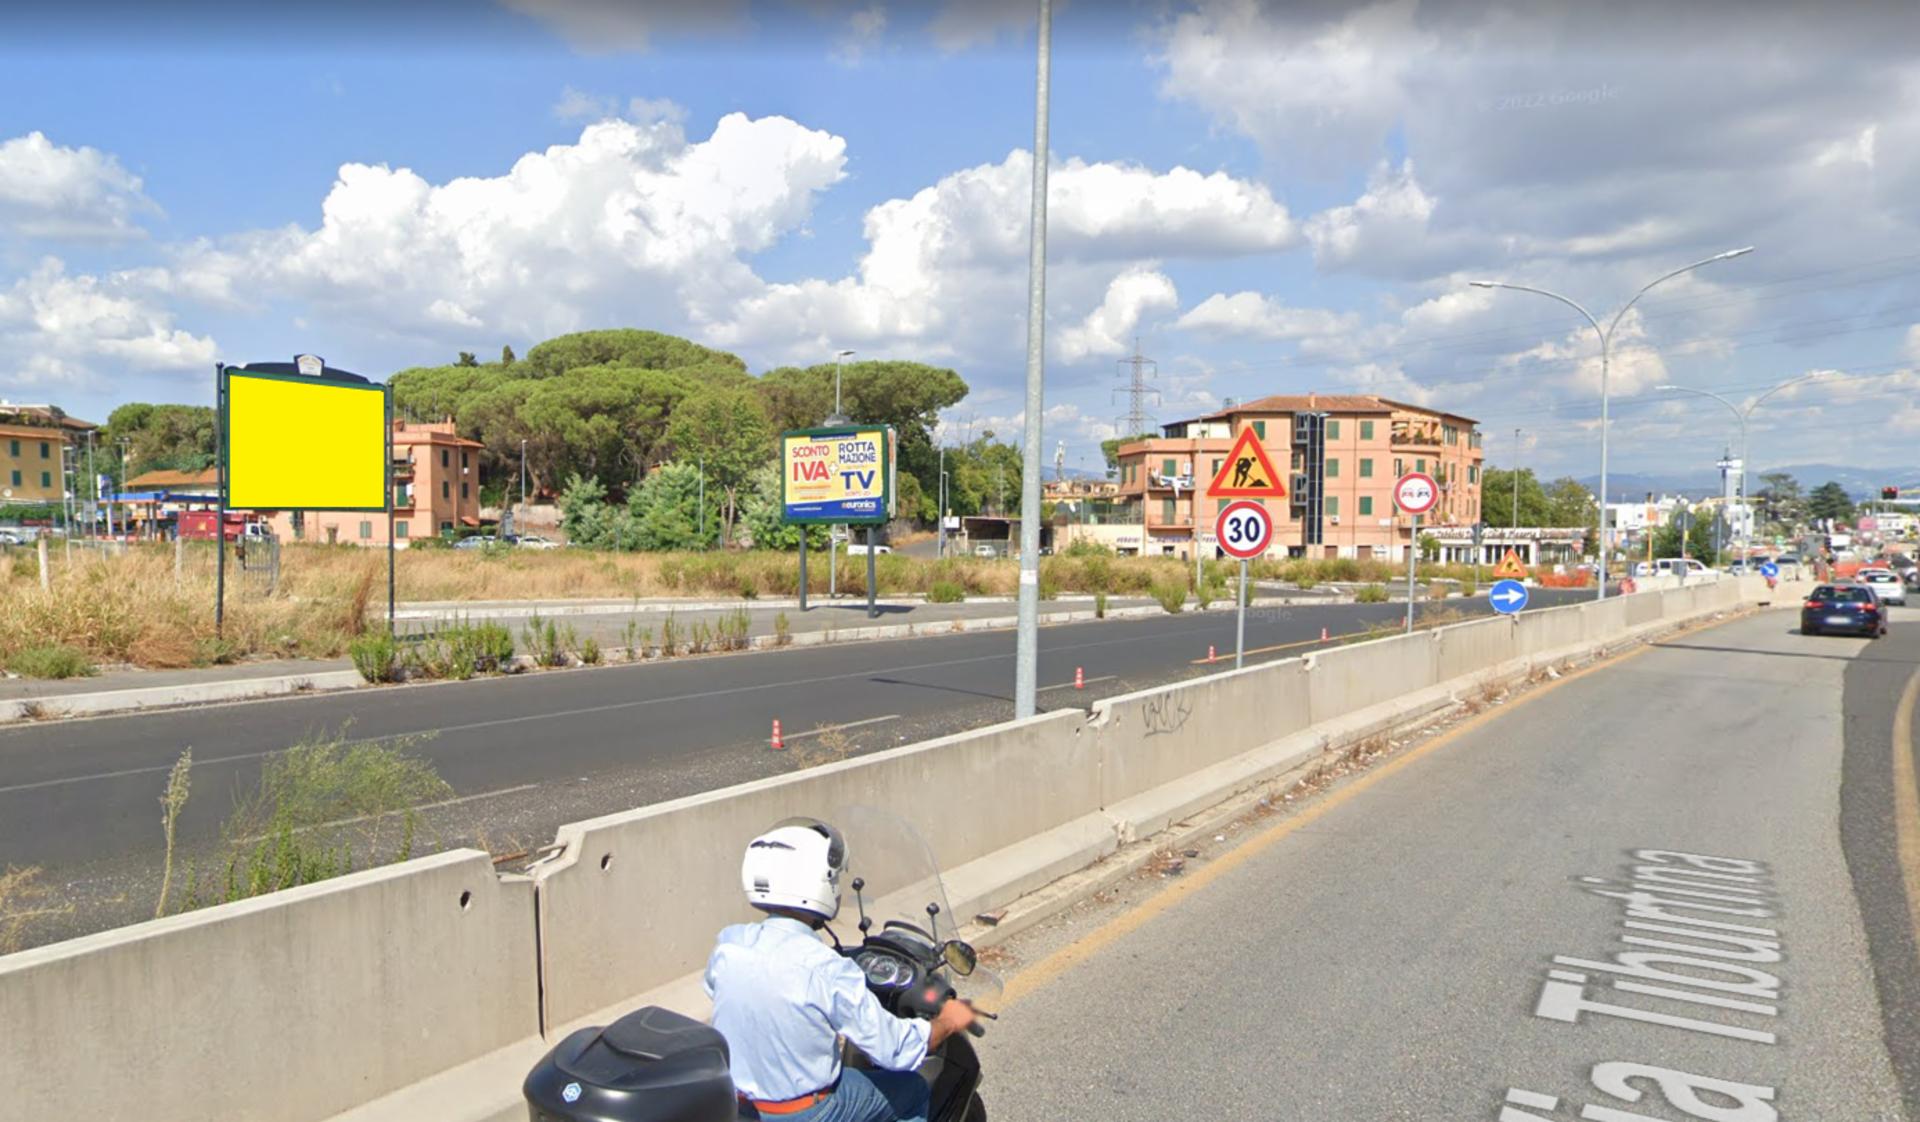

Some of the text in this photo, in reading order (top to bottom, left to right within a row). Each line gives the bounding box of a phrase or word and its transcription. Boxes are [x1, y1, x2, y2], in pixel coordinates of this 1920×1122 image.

[792, 445, 830, 458] SCONTO
[838, 441, 875, 453] ROTTA
[838, 452, 876, 463] MAZIONE
[793, 461, 830, 481] IVA
[840, 470, 875, 489] TV
[1229, 516, 1260, 543] 30
[1499, 848, 1782, 1122] ia Tiburtina
